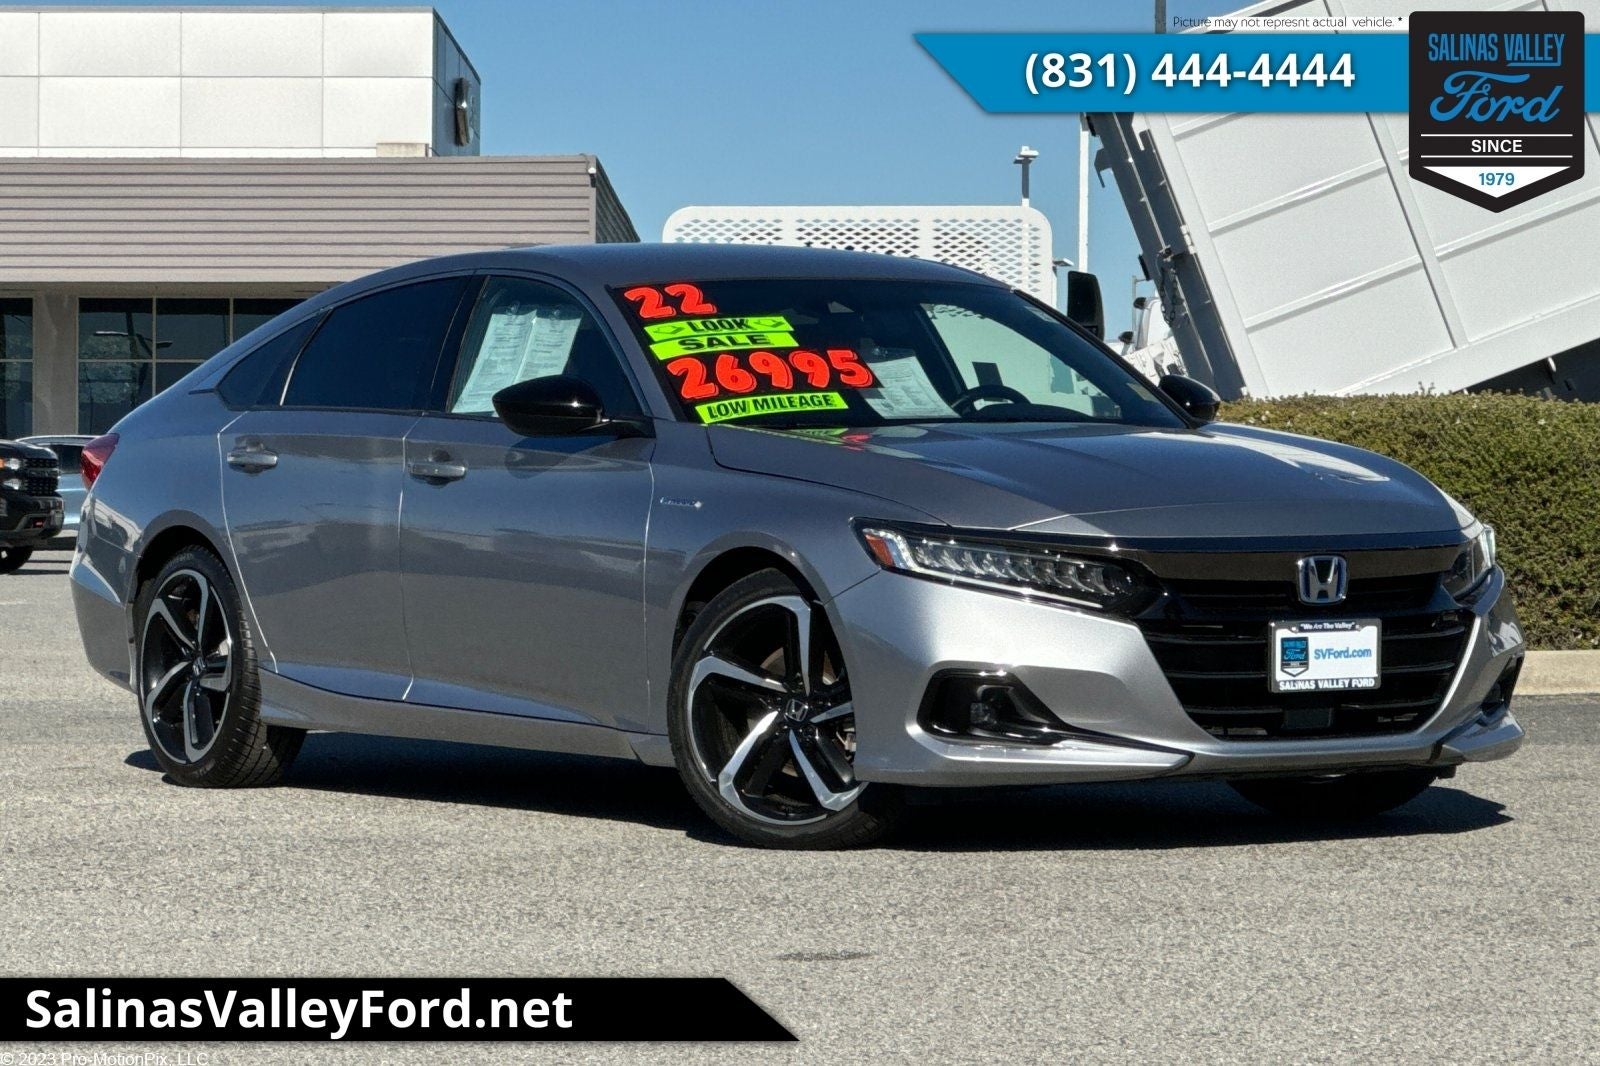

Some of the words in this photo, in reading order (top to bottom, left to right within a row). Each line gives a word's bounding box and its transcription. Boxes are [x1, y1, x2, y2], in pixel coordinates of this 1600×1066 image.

[624, 284, 718, 319] 22
[687, 319, 750, 332] LOOK
[678, 334, 770, 350] SALE
[667, 349, 874, 400] 26995
[707, 402, 746, 419] LOW
[754, 394, 834, 412] MILEAGE
[1314, 647, 1373, 660] SVFord.com
[1279, 681, 1316, 691] SALINAS
[1317, 679, 1350, 689] VALLEY
[1351, 678, 1376, 688] FORD
